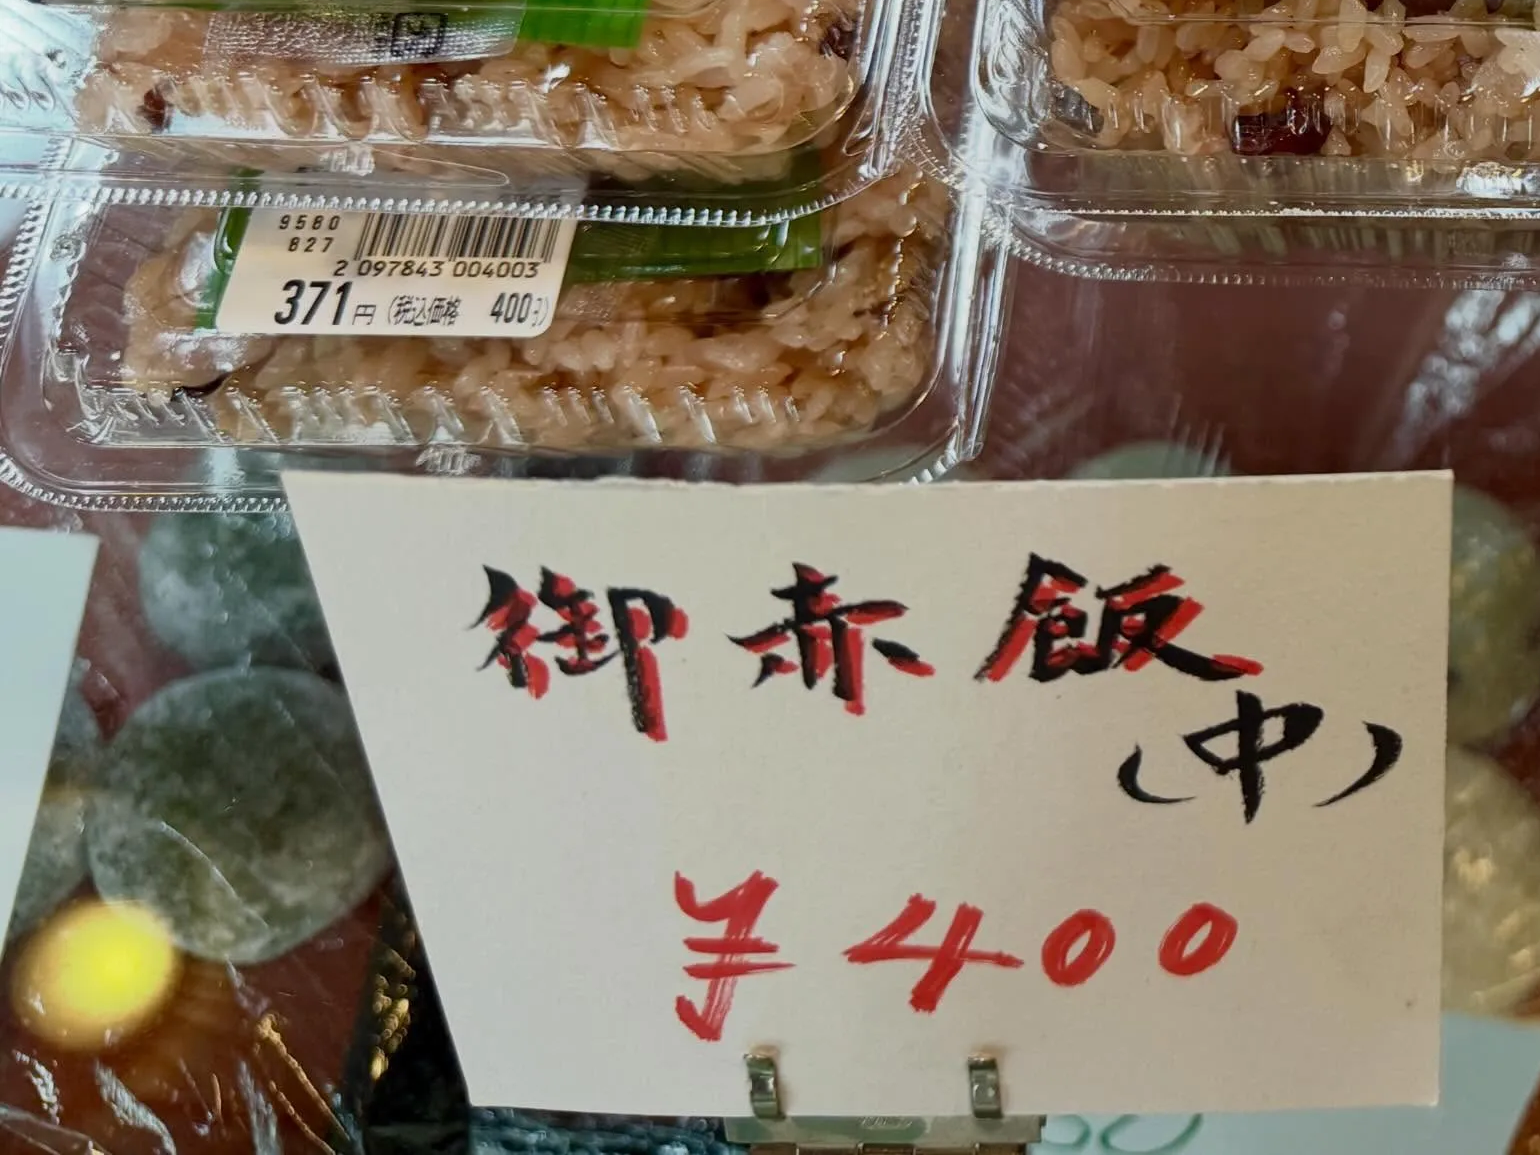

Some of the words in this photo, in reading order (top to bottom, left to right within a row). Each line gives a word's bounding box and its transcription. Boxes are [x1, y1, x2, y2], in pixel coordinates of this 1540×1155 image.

[278, 214, 341, 231] 9580
[287, 236, 334, 253] 827
[474, 550, 1264, 742] 御赤飯
[1116, 689, 1403, 824] （中）
[673, 870, 1240, 1042] ¥400
